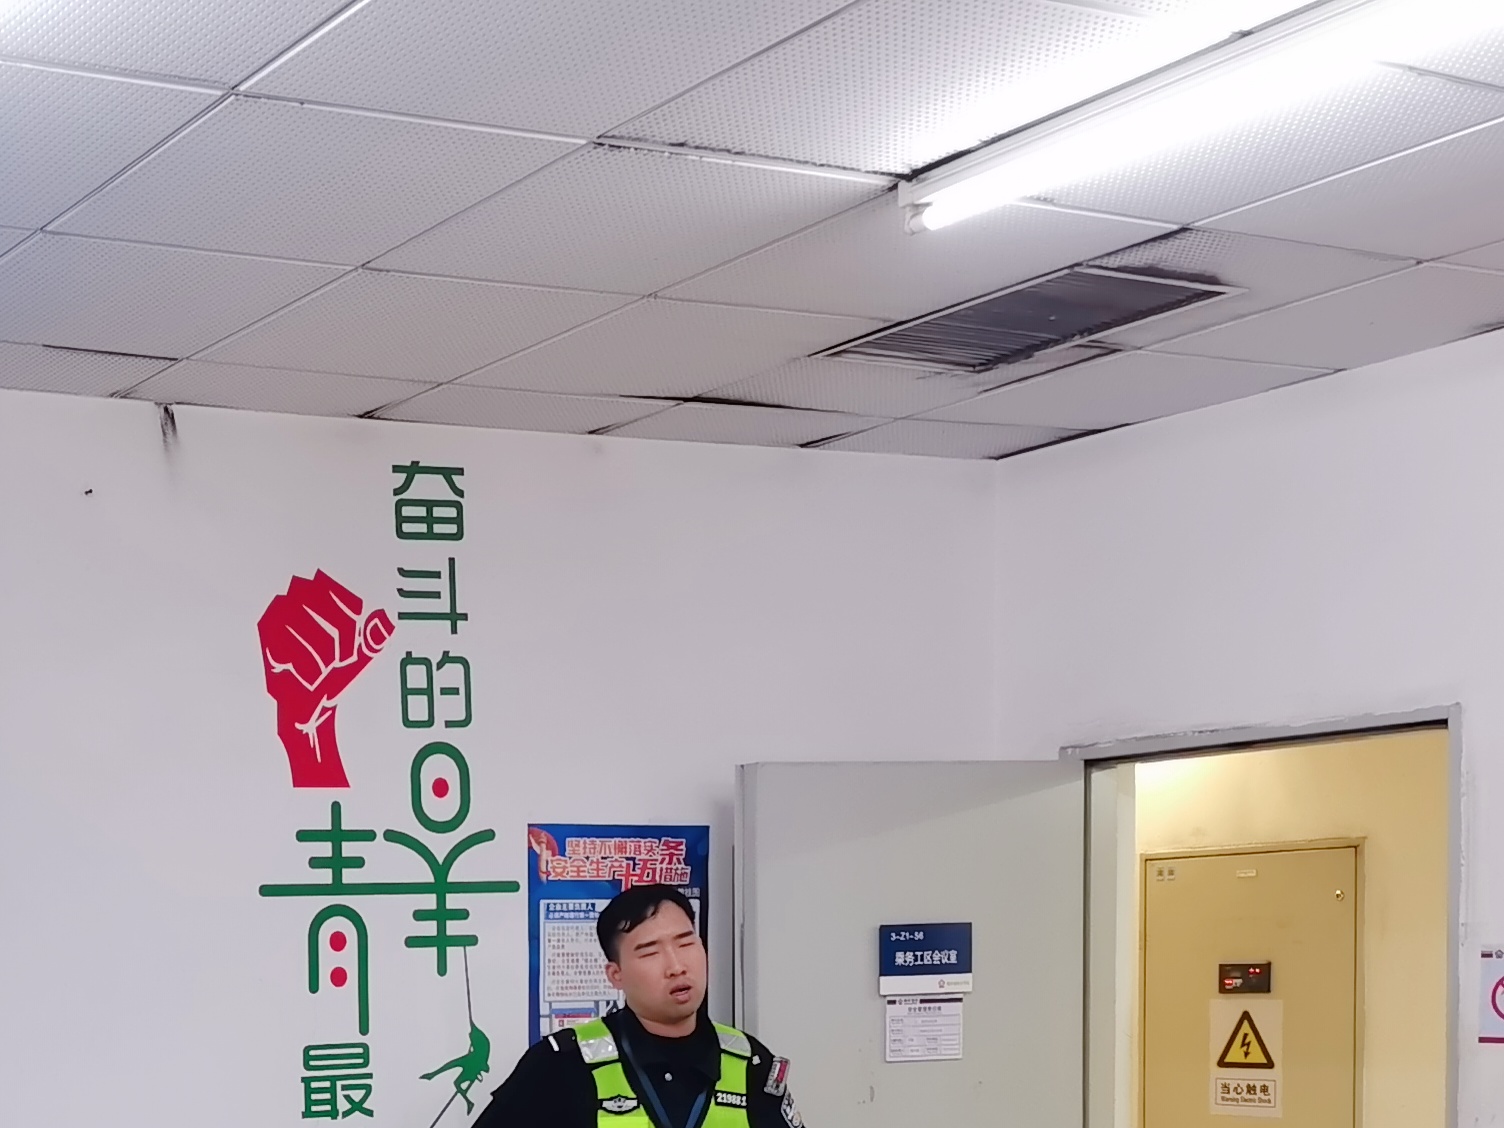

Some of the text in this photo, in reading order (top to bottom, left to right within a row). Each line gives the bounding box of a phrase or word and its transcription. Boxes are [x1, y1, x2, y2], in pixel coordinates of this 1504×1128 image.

[392, 461, 473, 729] 奋斗的
[1220, 1081, 1270, 1096] 当心触电
